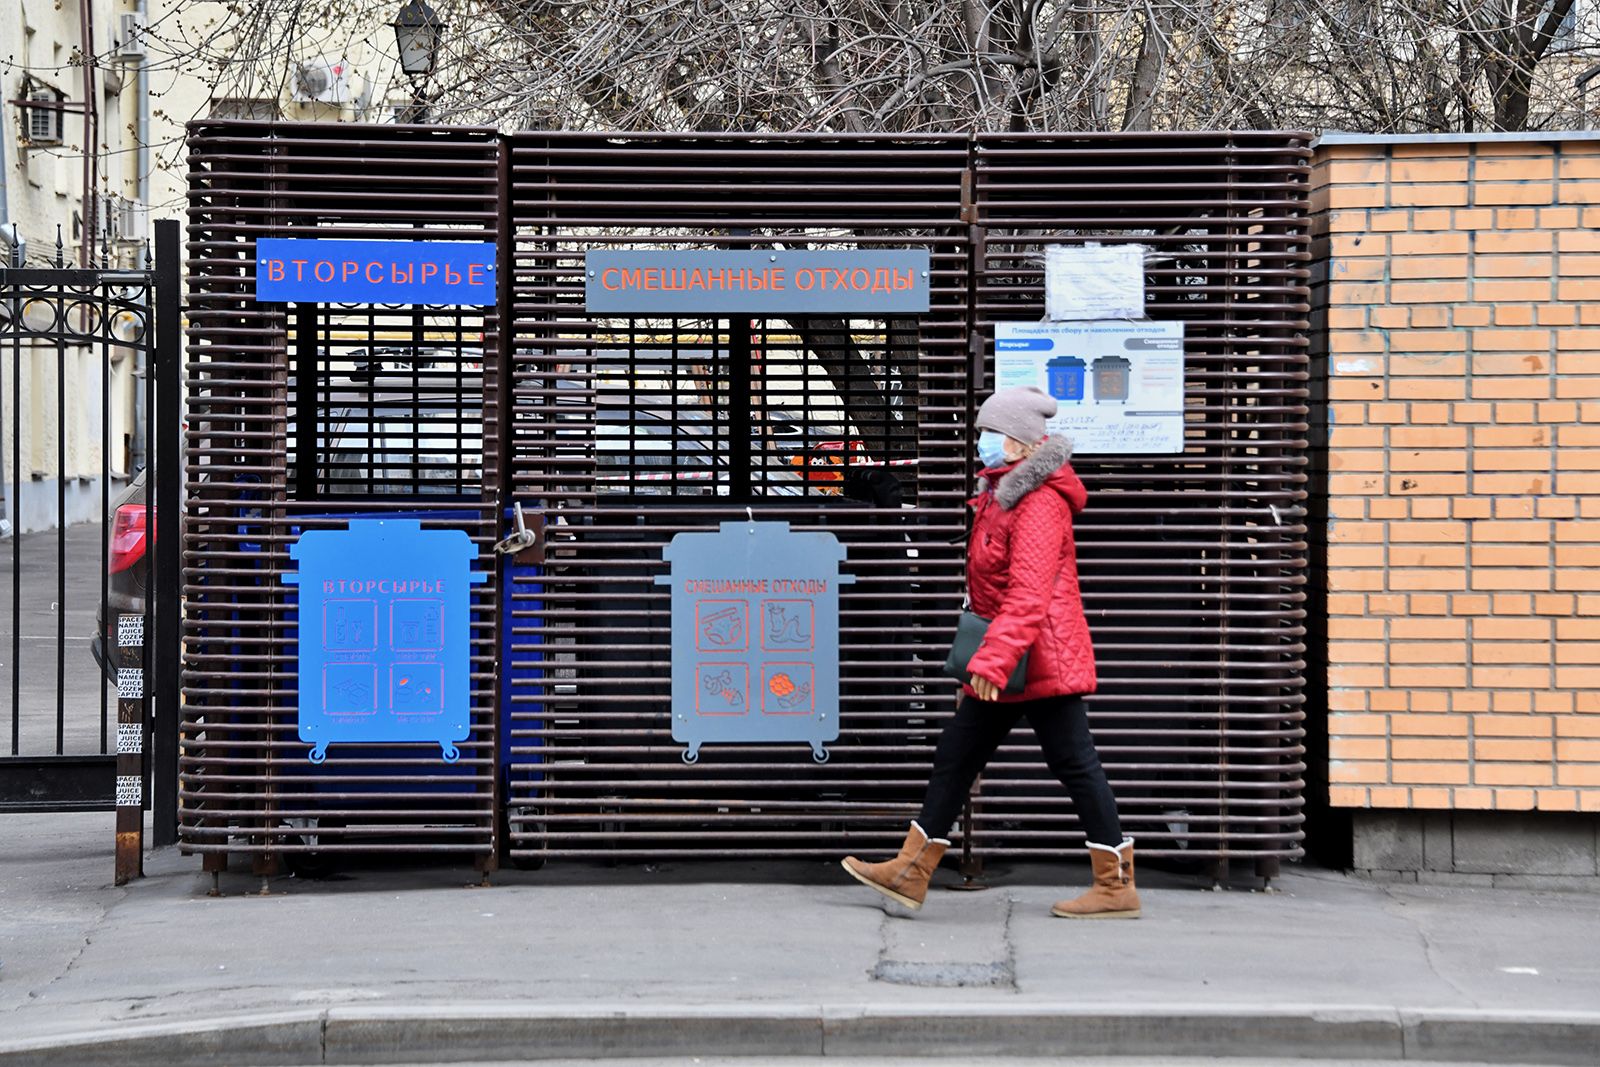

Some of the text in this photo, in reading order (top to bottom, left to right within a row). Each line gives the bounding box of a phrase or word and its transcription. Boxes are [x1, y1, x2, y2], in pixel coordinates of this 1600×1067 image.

[268, 259, 485, 286] ВТОРСЫРЬЕ
[601, 267, 914, 294] СМЕШАННЫЕ ОТХОДЫ
[323, 580, 446, 594] ВТОРСЫРЬЕ
[685, 579, 827, 595] СМЕШАННЫЕ ОТХОДЫ
